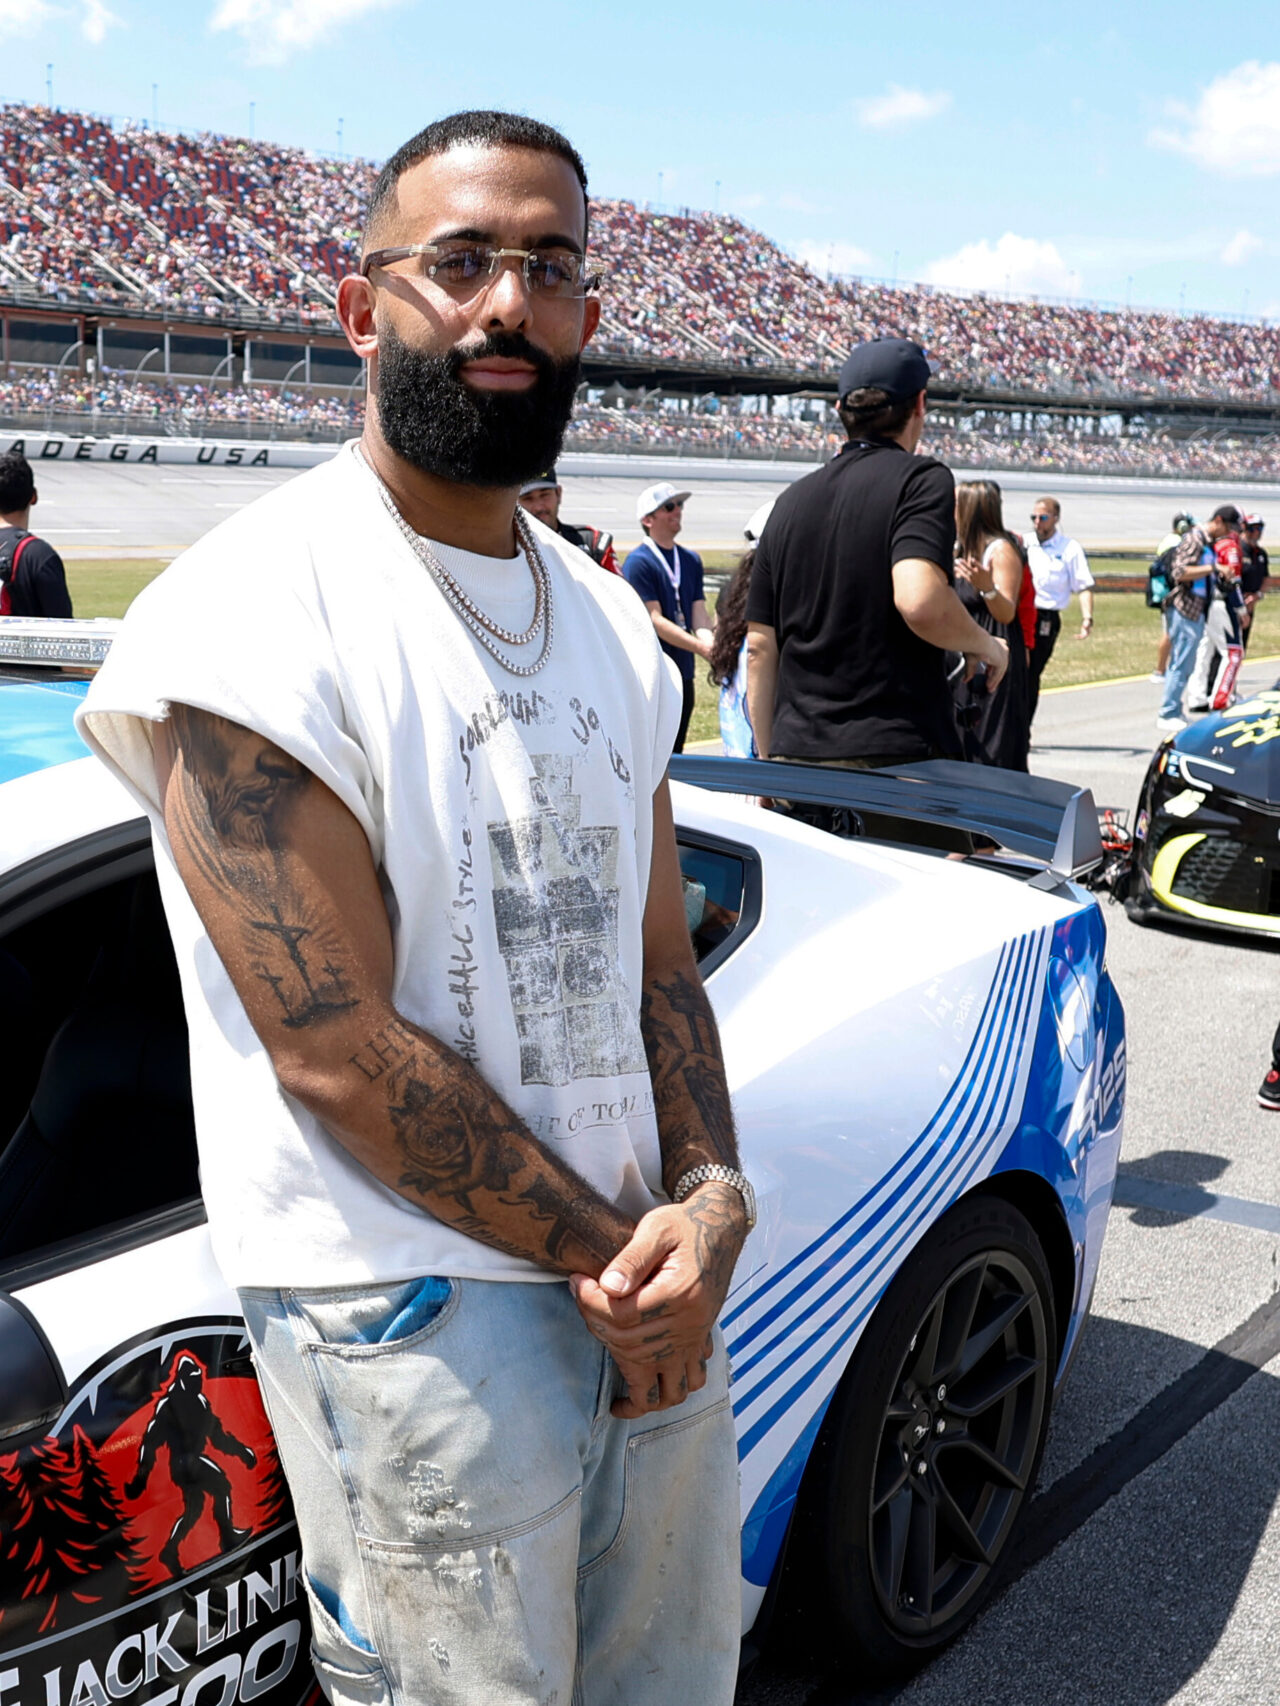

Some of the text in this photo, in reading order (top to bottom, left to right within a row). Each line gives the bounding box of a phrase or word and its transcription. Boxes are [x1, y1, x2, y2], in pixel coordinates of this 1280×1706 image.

[196, 447, 269, 466] USA
[43, 1609, 191, 1706] JACK
[140, 1619, 301, 1706] 00
